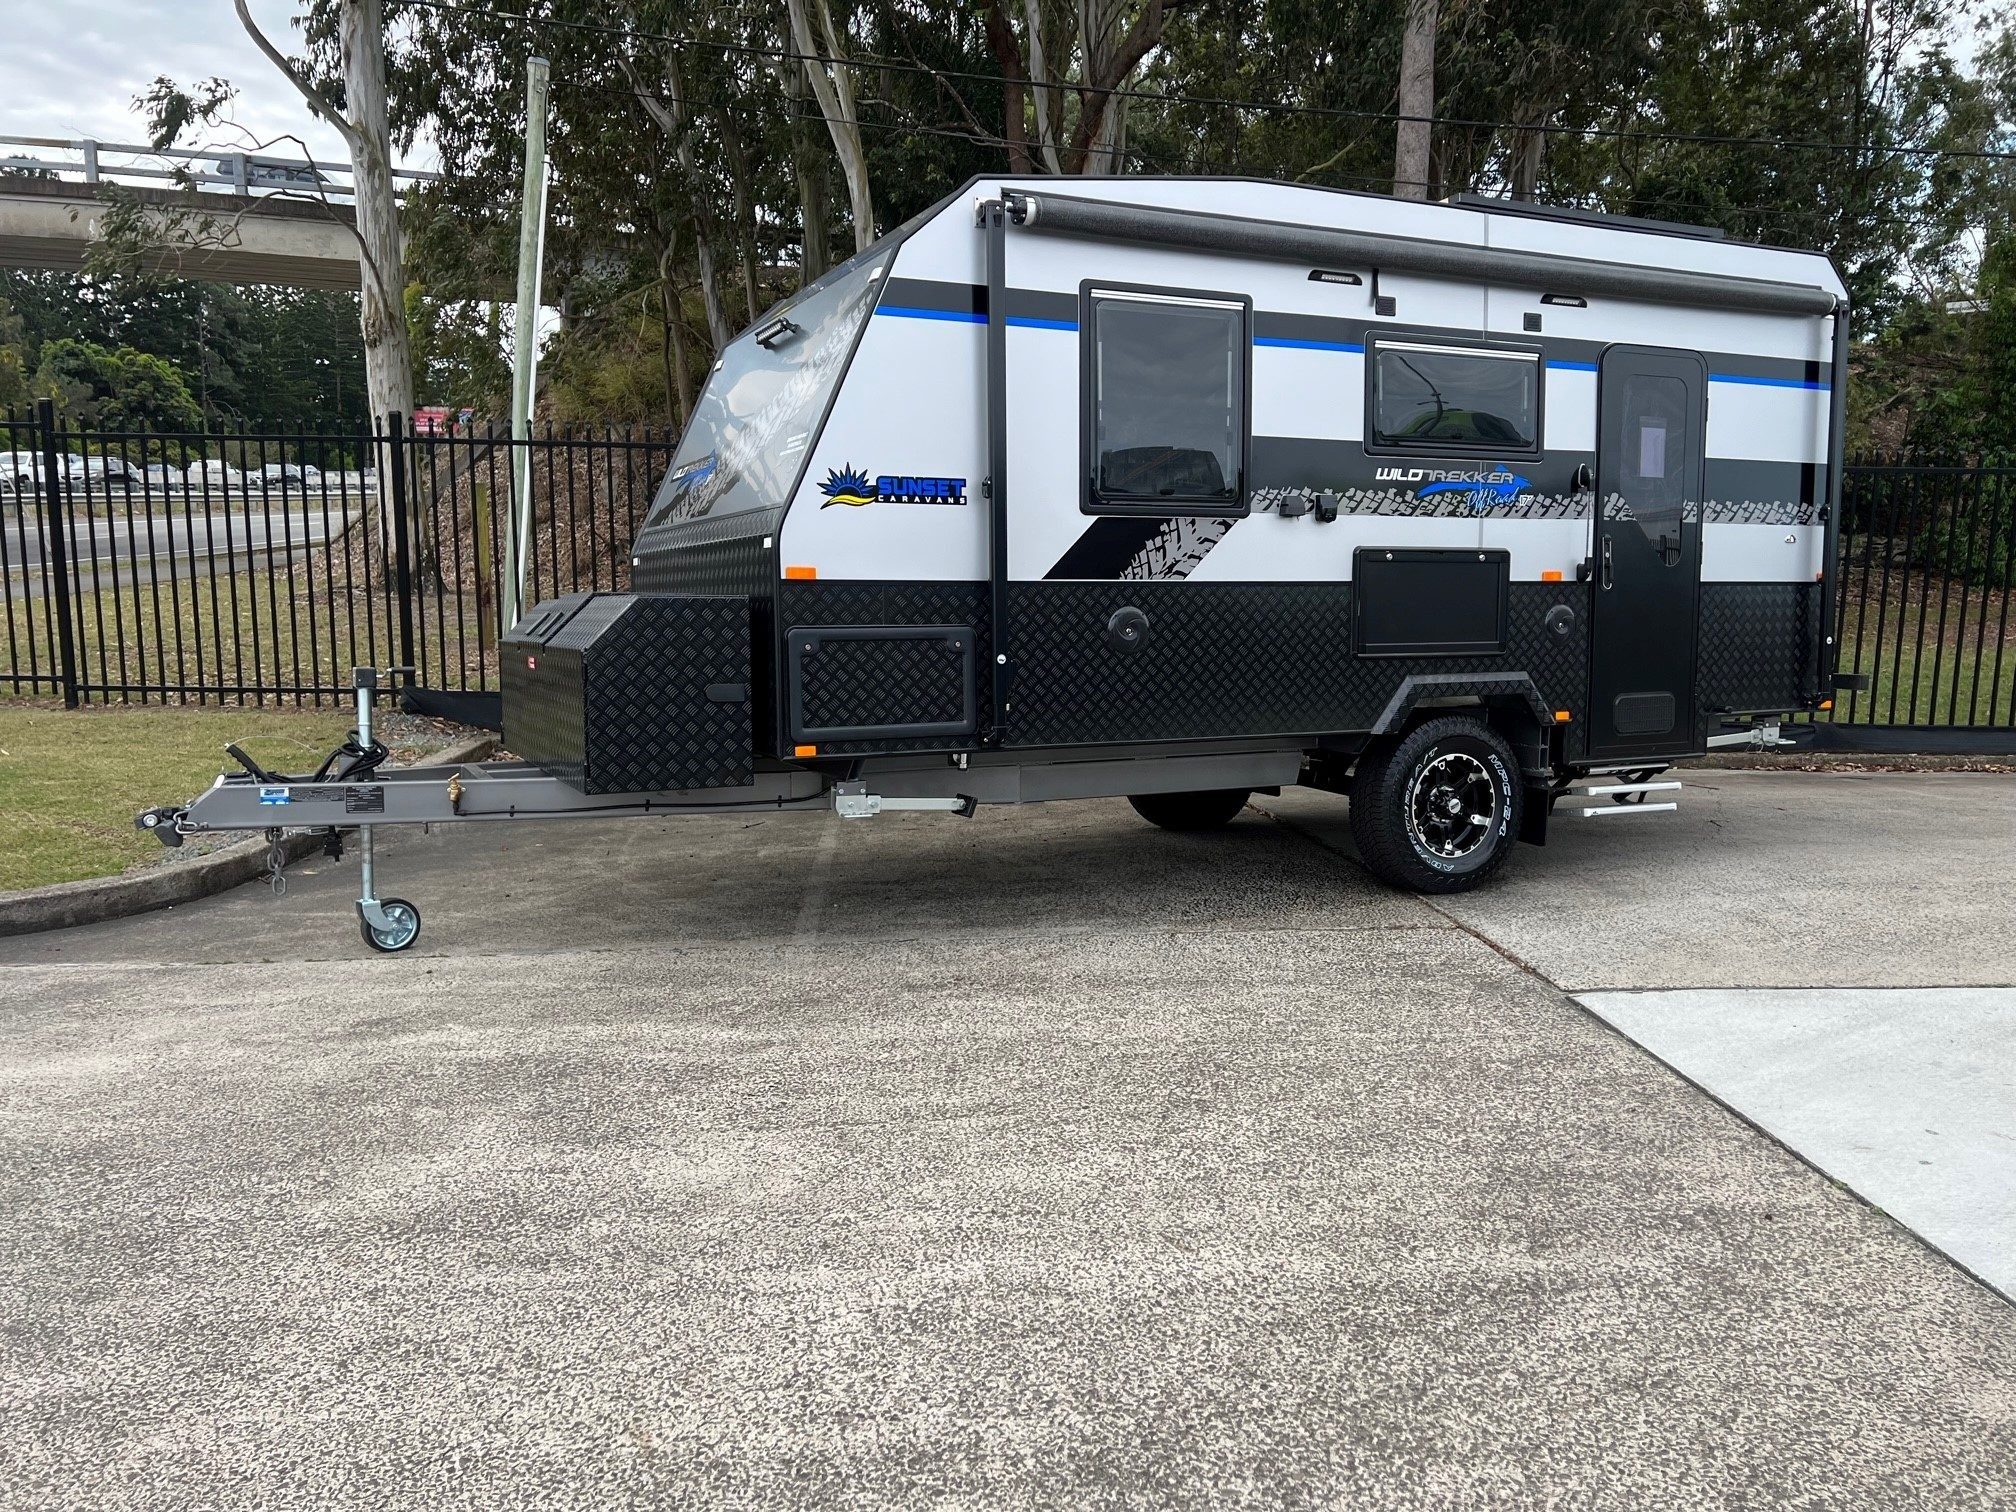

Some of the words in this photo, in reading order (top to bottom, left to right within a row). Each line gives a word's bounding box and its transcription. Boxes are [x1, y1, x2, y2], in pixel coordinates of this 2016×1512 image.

[1375, 467, 1514, 485] WILDTREKKER
[877, 478, 965, 496] SUNSET
[877, 495, 966, 504] CARAVANS
